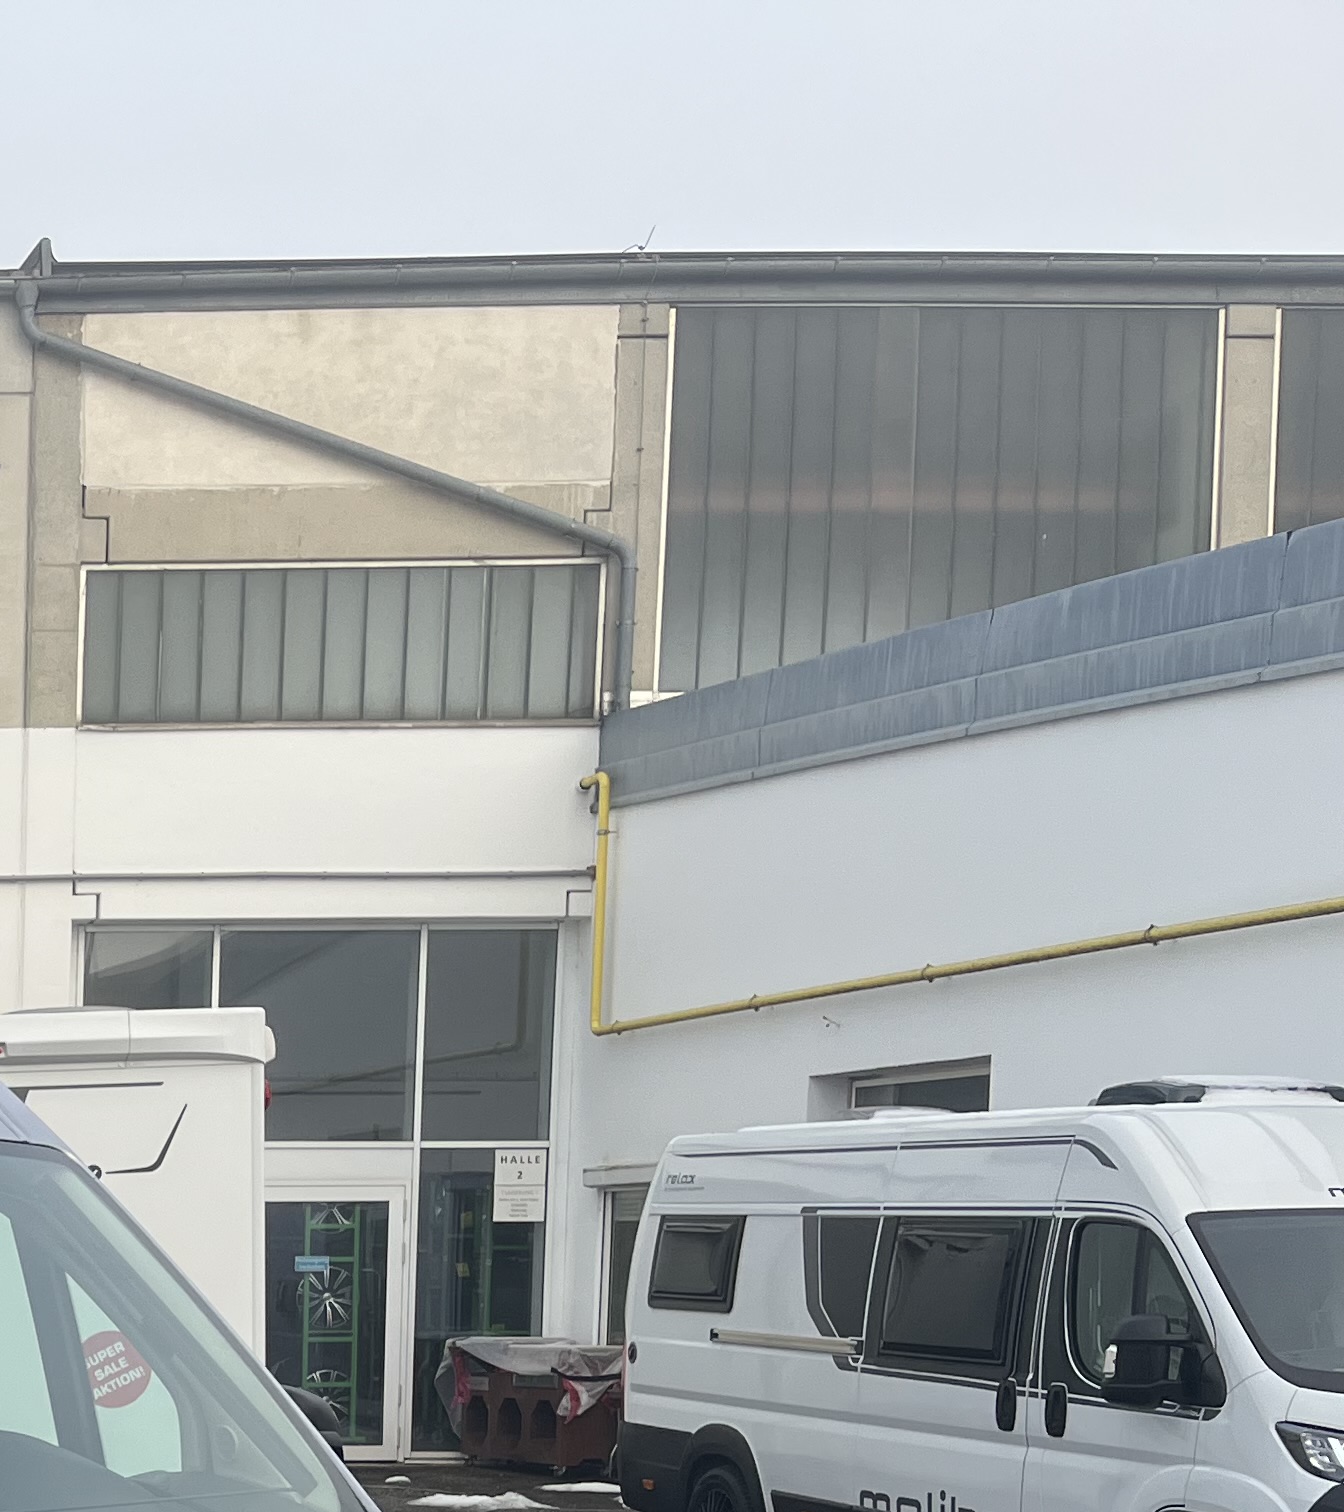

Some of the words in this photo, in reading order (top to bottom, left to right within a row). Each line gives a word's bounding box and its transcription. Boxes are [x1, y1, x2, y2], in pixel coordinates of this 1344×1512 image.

[500, 1155, 541, 1164] HALLE
[517, 1170, 523, 1180] 2
[665, 1172, 696, 1184] relax
[94, 1356, 129, 1381] SALE
[93, 1366, 146, 1400] AKTION!
